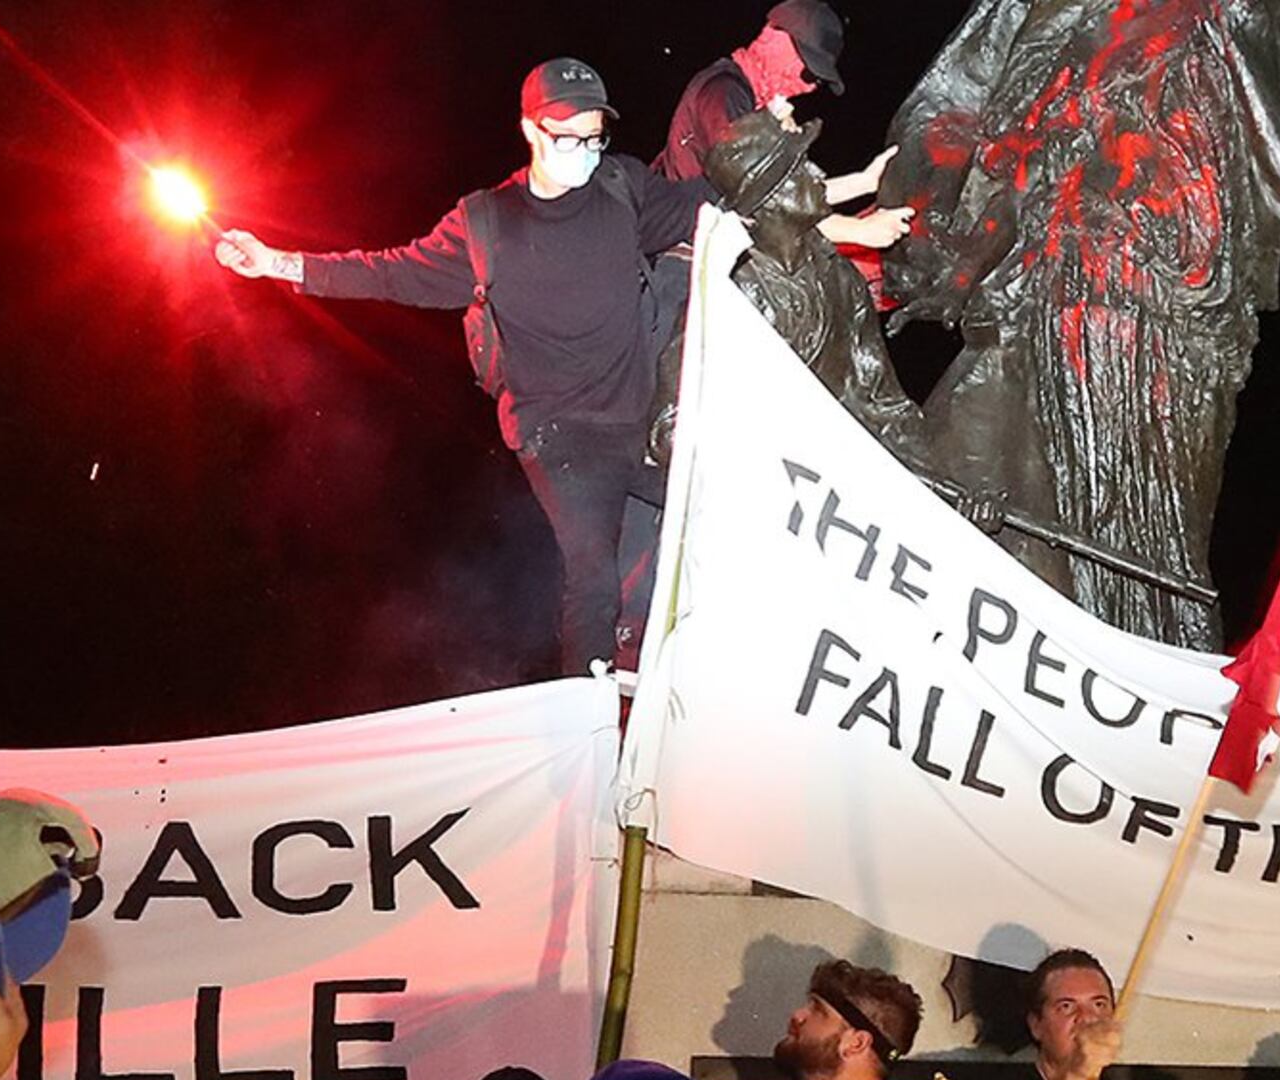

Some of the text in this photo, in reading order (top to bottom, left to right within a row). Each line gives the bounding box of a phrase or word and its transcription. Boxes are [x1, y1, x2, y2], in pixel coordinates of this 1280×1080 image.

[782, 458, 932, 600] THE
[795, 629, 1006, 798] FALL
[1041, 754, 1180, 843] OF
[70, 807, 481, 920] ACK
